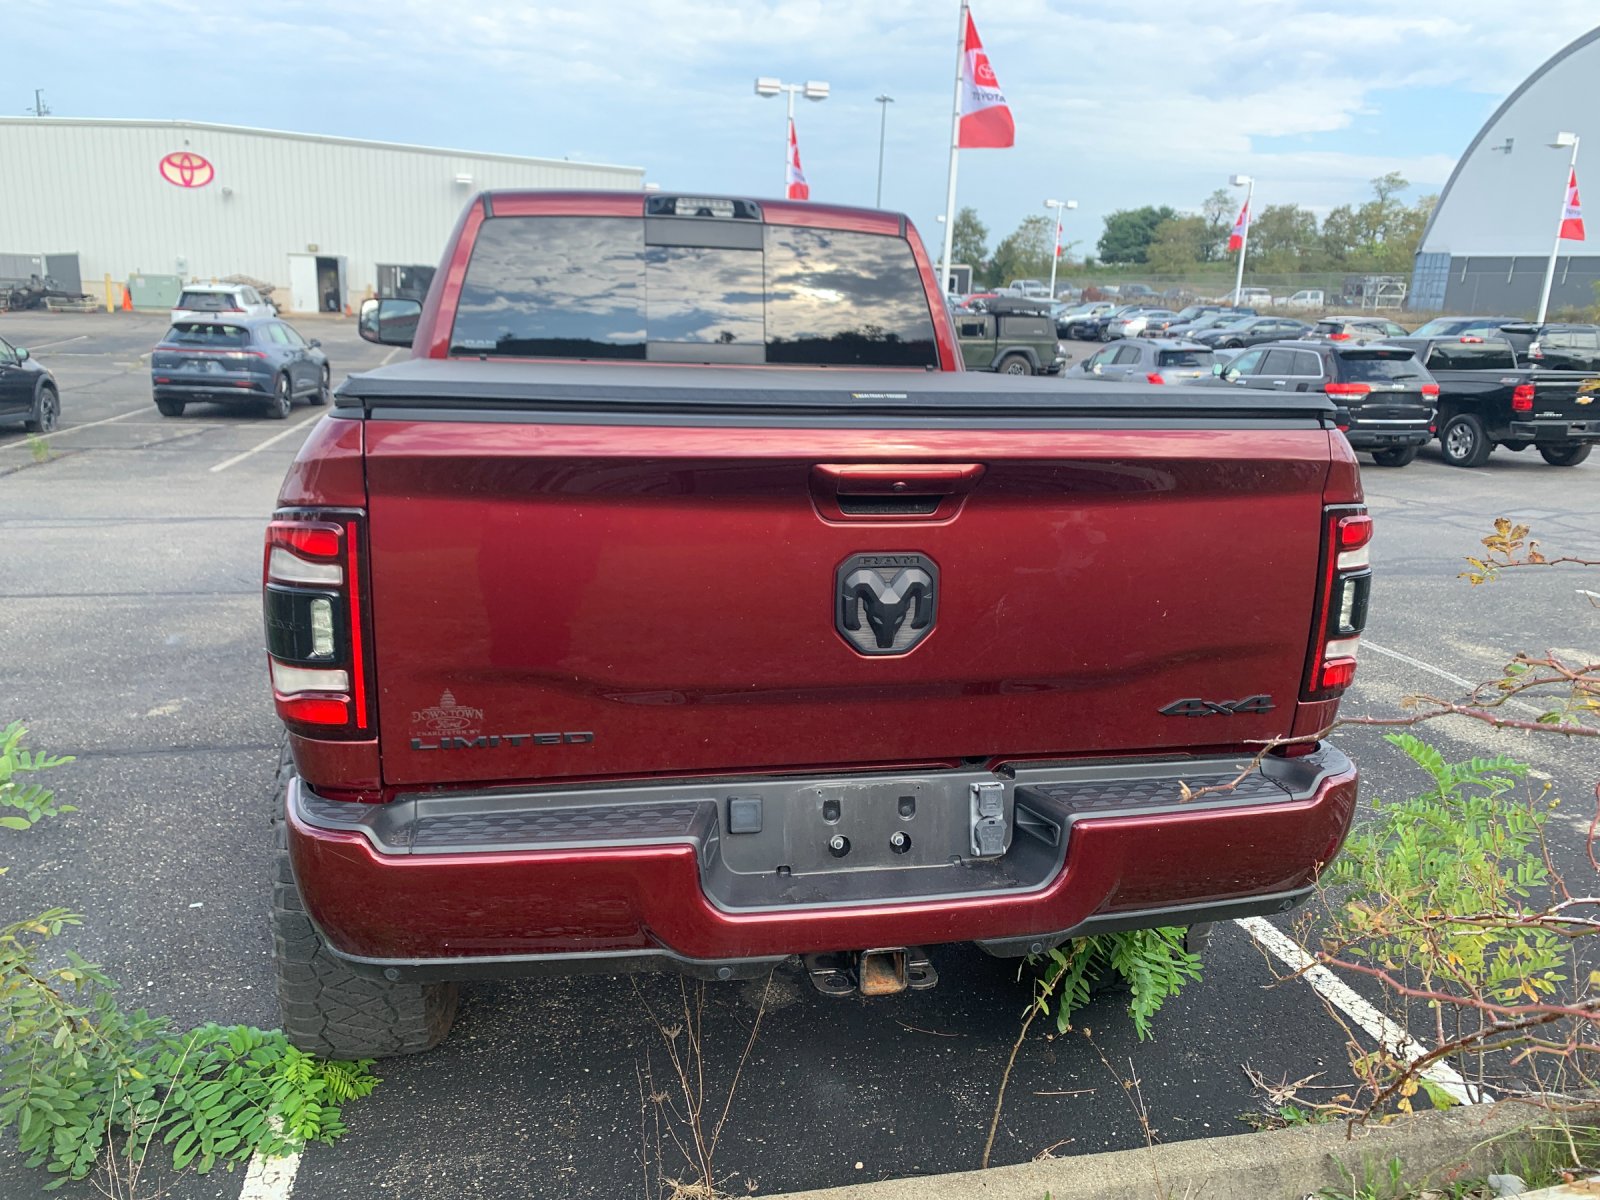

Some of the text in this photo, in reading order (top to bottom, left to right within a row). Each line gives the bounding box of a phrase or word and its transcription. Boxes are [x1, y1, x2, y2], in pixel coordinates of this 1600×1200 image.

[860, 555, 920, 567] RAM
[411, 708, 484, 723] DOWNTOWN
[410, 731, 595, 751] LIMITED
